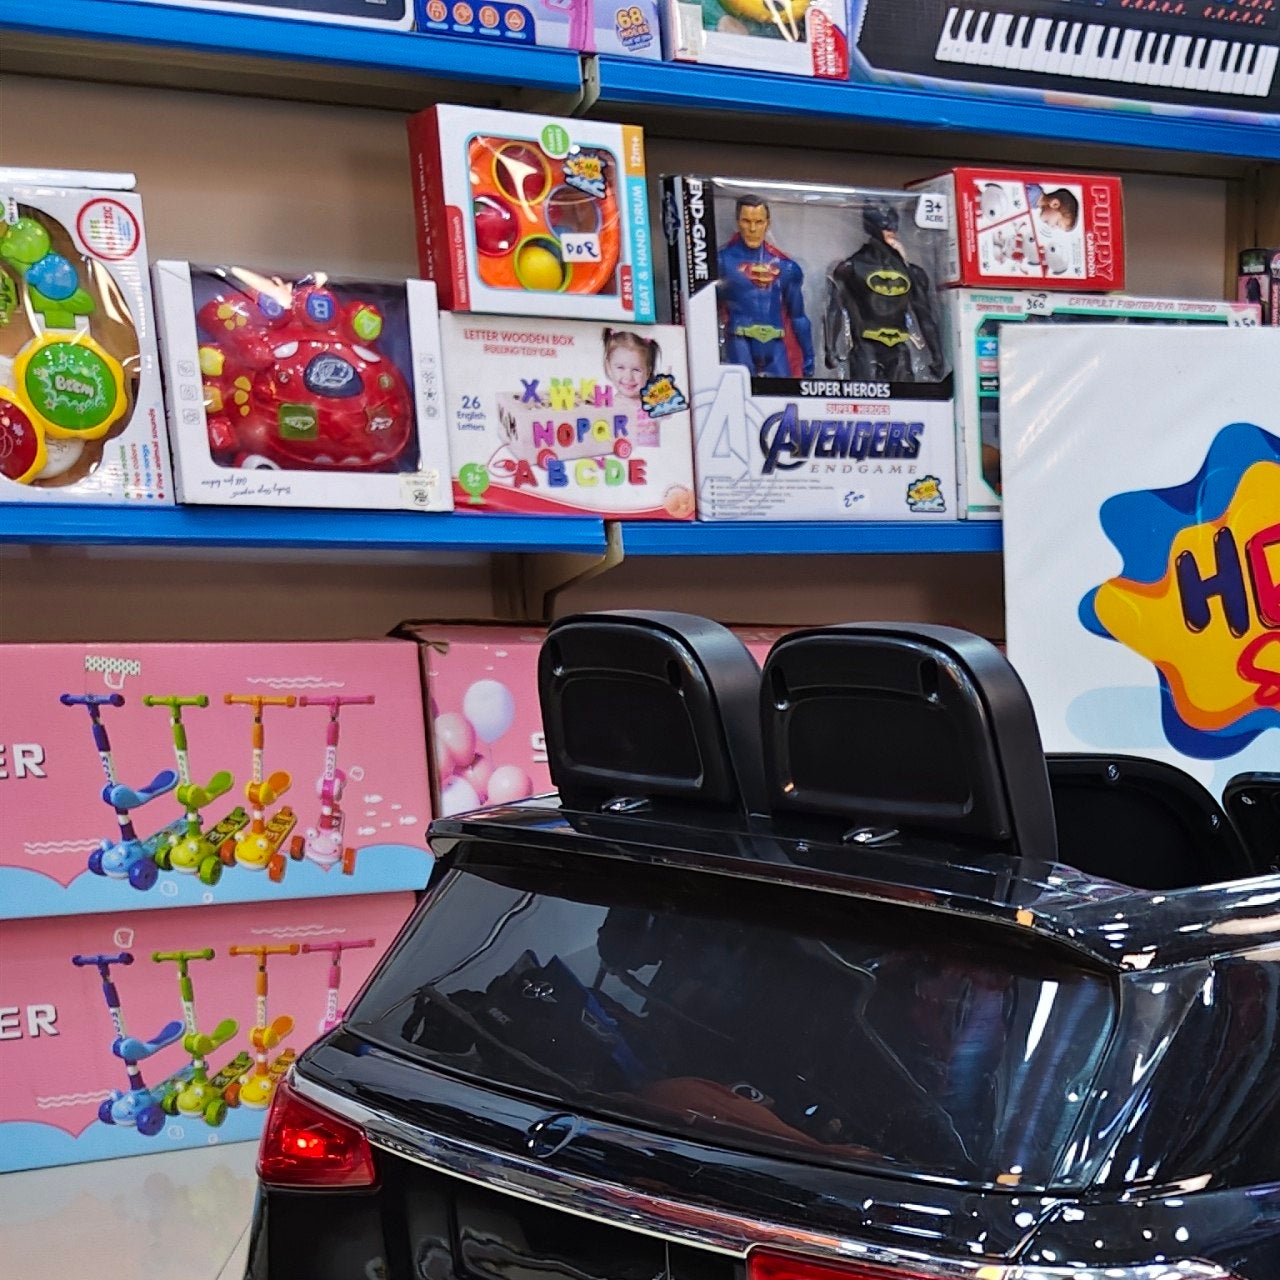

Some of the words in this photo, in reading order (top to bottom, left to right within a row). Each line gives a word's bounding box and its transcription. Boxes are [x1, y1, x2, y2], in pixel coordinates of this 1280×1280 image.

[615, 6, 644, 30] 68
[632, 185, 644, 225] DRUM
[1091, 186, 1114, 281] PUPPY
[636, 230, 648, 267] HAND
[1086, 233, 1096, 278] CARTOON
[638, 283, 650, 315] BEAT
[1068, 297, 1113, 308] CATAPULT
[1177, 303, 1217, 313] TORPEDO
[463, 328, 498, 342] LETTER
[500, 330, 550, 345] WOODEN
[552, 333, 575, 346] BOX
[461, 395, 481, 410] 26
[800, 381, 842, 396] SUPER
[844, 382, 891, 398] HEROES
[759, 402, 926, 476] AVENGERS
[810, 462, 918, 475] ENDGAME
